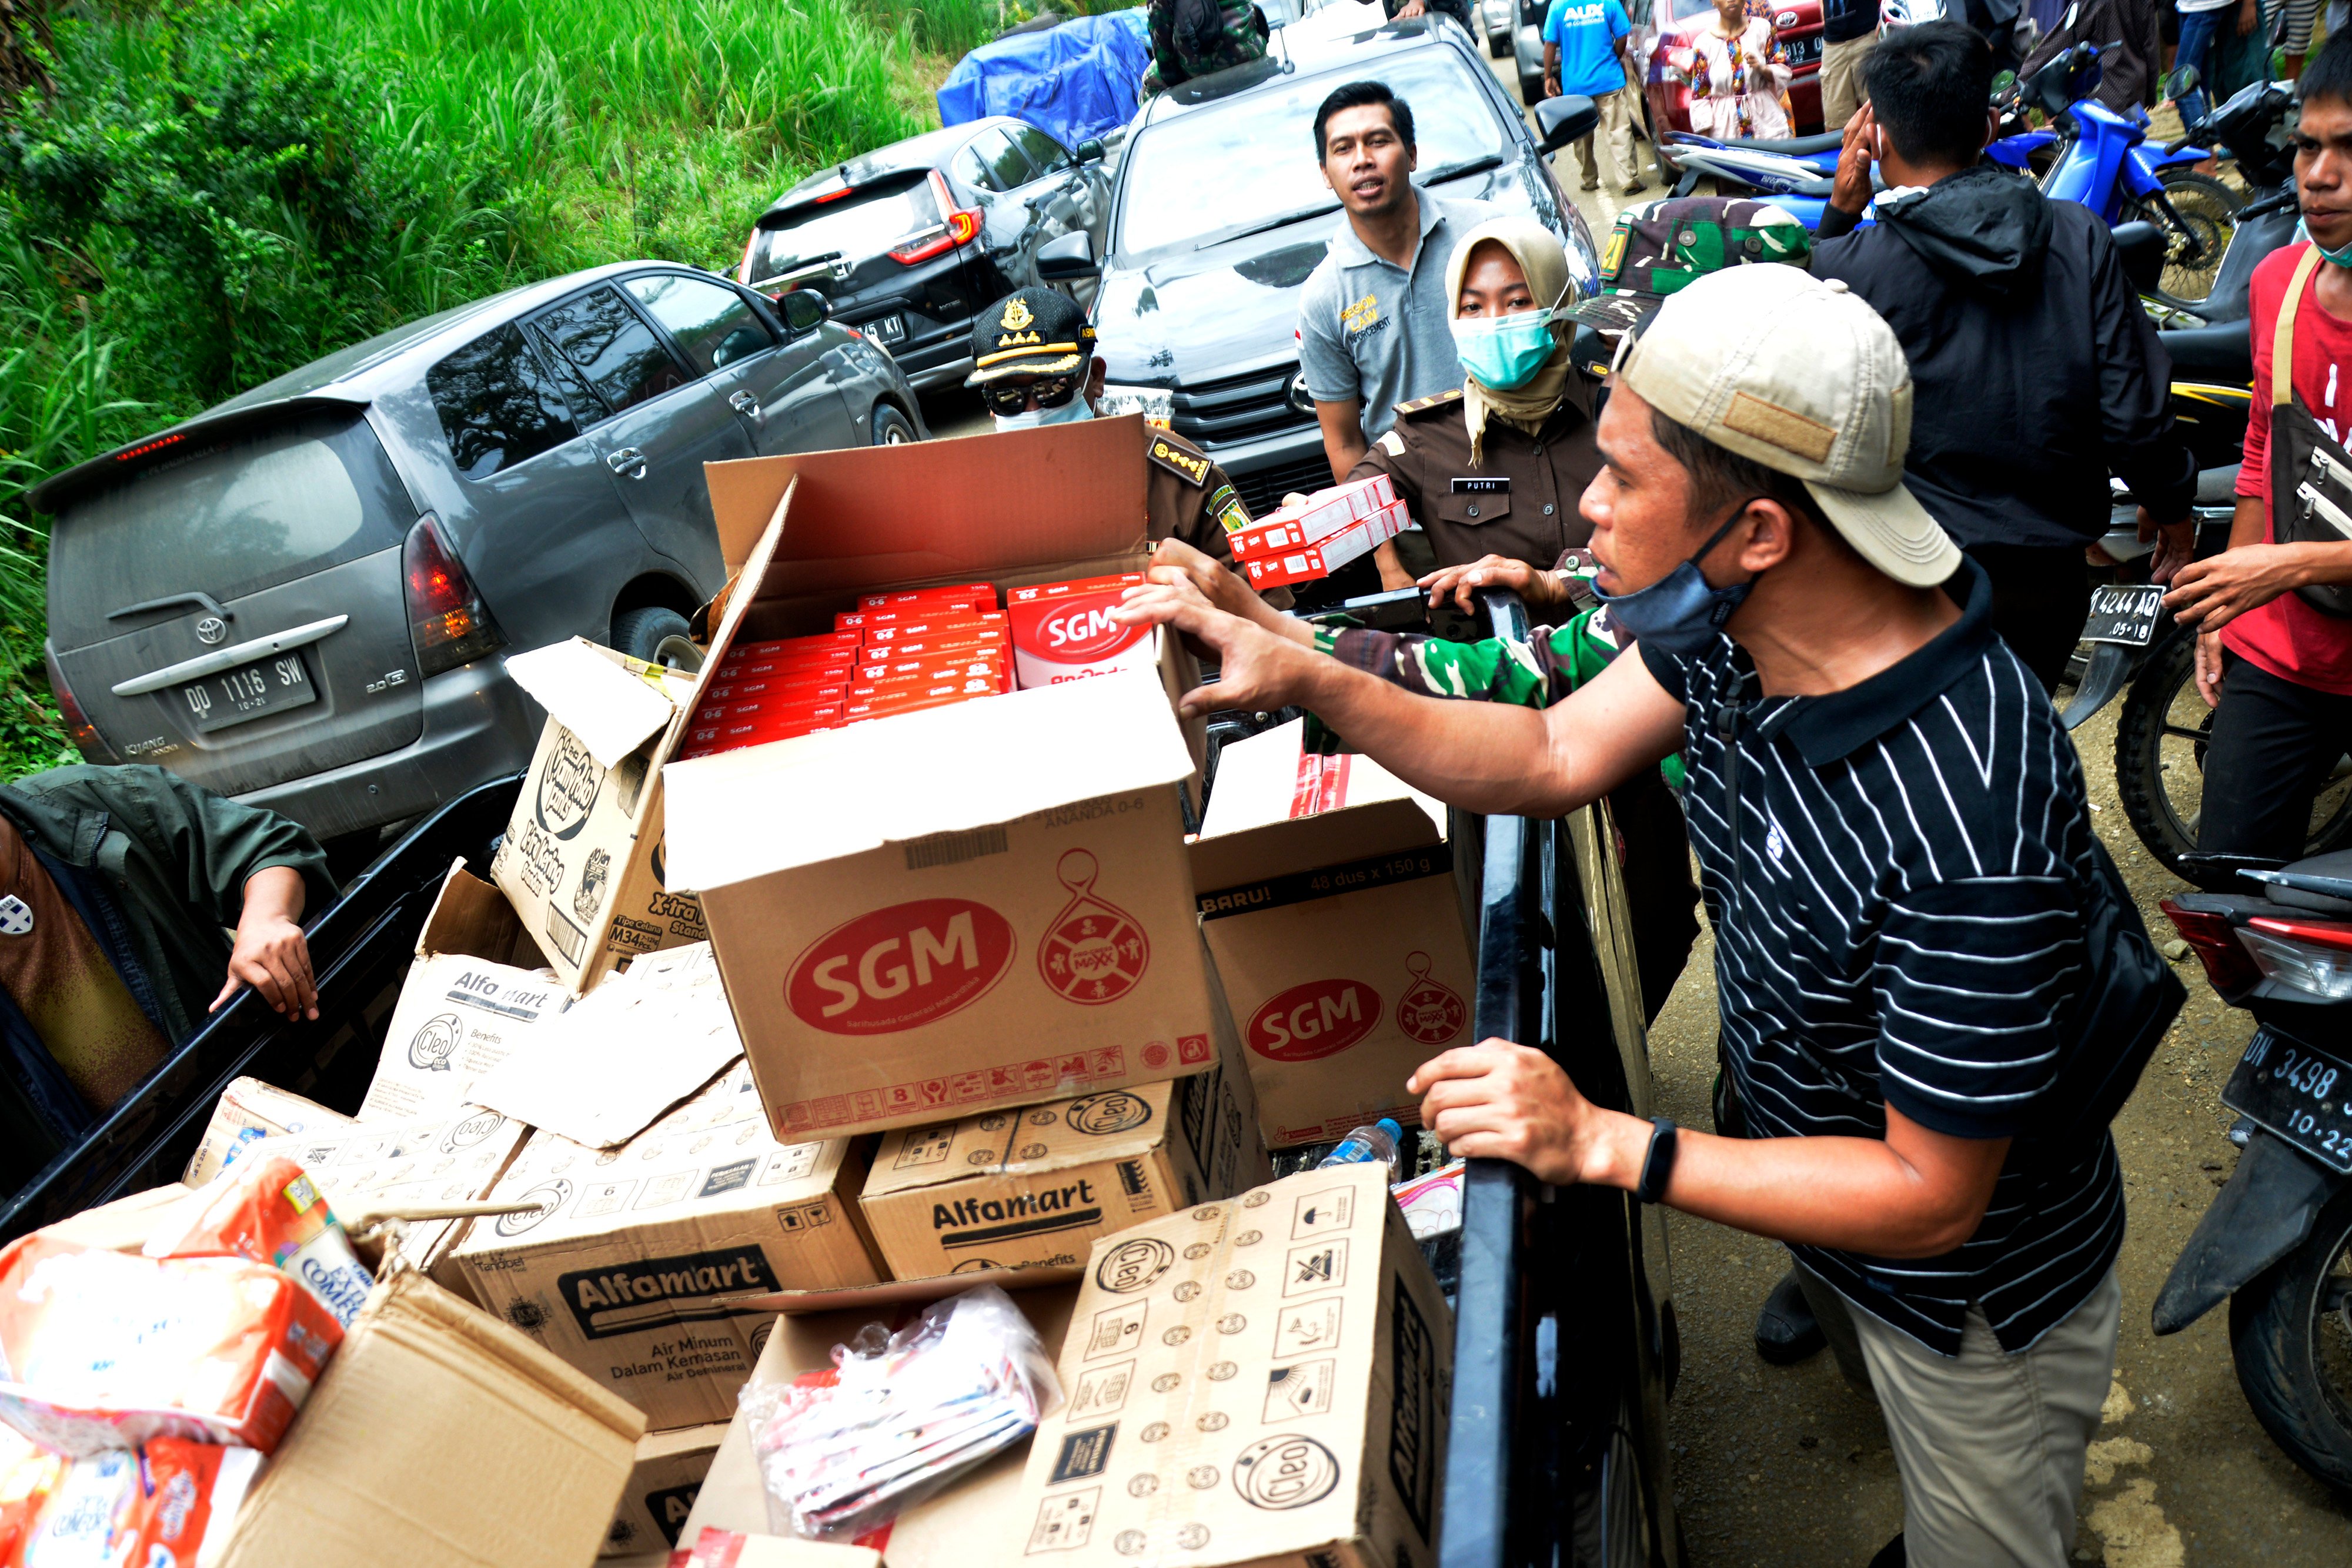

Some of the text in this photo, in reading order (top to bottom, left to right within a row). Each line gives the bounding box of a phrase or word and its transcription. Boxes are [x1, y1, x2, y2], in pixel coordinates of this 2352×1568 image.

[1563, 3, 1604, 21] AUX
[1341, 293, 1377, 322] REGION
[1349, 307, 1379, 333] LAW
[884, 316, 899, 335] KT
[1467, 482, 1495, 490] PUTRI
[2134, 591, 2159, 617] AQ
[1048, 605, 1117, 647] SGM
[184, 657, 302, 713] DD 1116 SW
[743, 683, 766, 692] SGM
[736, 704, 759, 713] SGM
[125, 735, 166, 756] KIJANG
[151, 743, 179, 757] INNOVA
[1044, 797, 1145, 830] ANANDA 0-6
[1310, 857, 1431, 891] 48 dus x 150 g
[1201, 885, 1272, 914] BARU!
[609, 926, 640, 947] M34
[617, 915, 662, 933] Tipe Celana
[812, 910, 980, 1018] SGM
[847, 976, 980, 1028] Sarihusada Generasi Mahardhika
[1261, 986, 1362, 1051] SGM
[420, 1031, 448, 1055] Cleo
[470, 1029, 502, 1044] Benefits
[2243, 1031, 2338, 1099] DN 3498
[893, 1088, 908, 1102] 8
[604, 1186, 615, 1196] 6
[933, 1179, 1095, 1229] Alfamart
[577, 1256, 760, 1310] Alfamart
[651, 1334, 734, 1359] Air Minum
[610, 1349, 741, 1379] Dalam Kemasan
[666, 1362, 747, 1382] Air Demineral
[1268, 1445, 1309, 1499] Cleo
